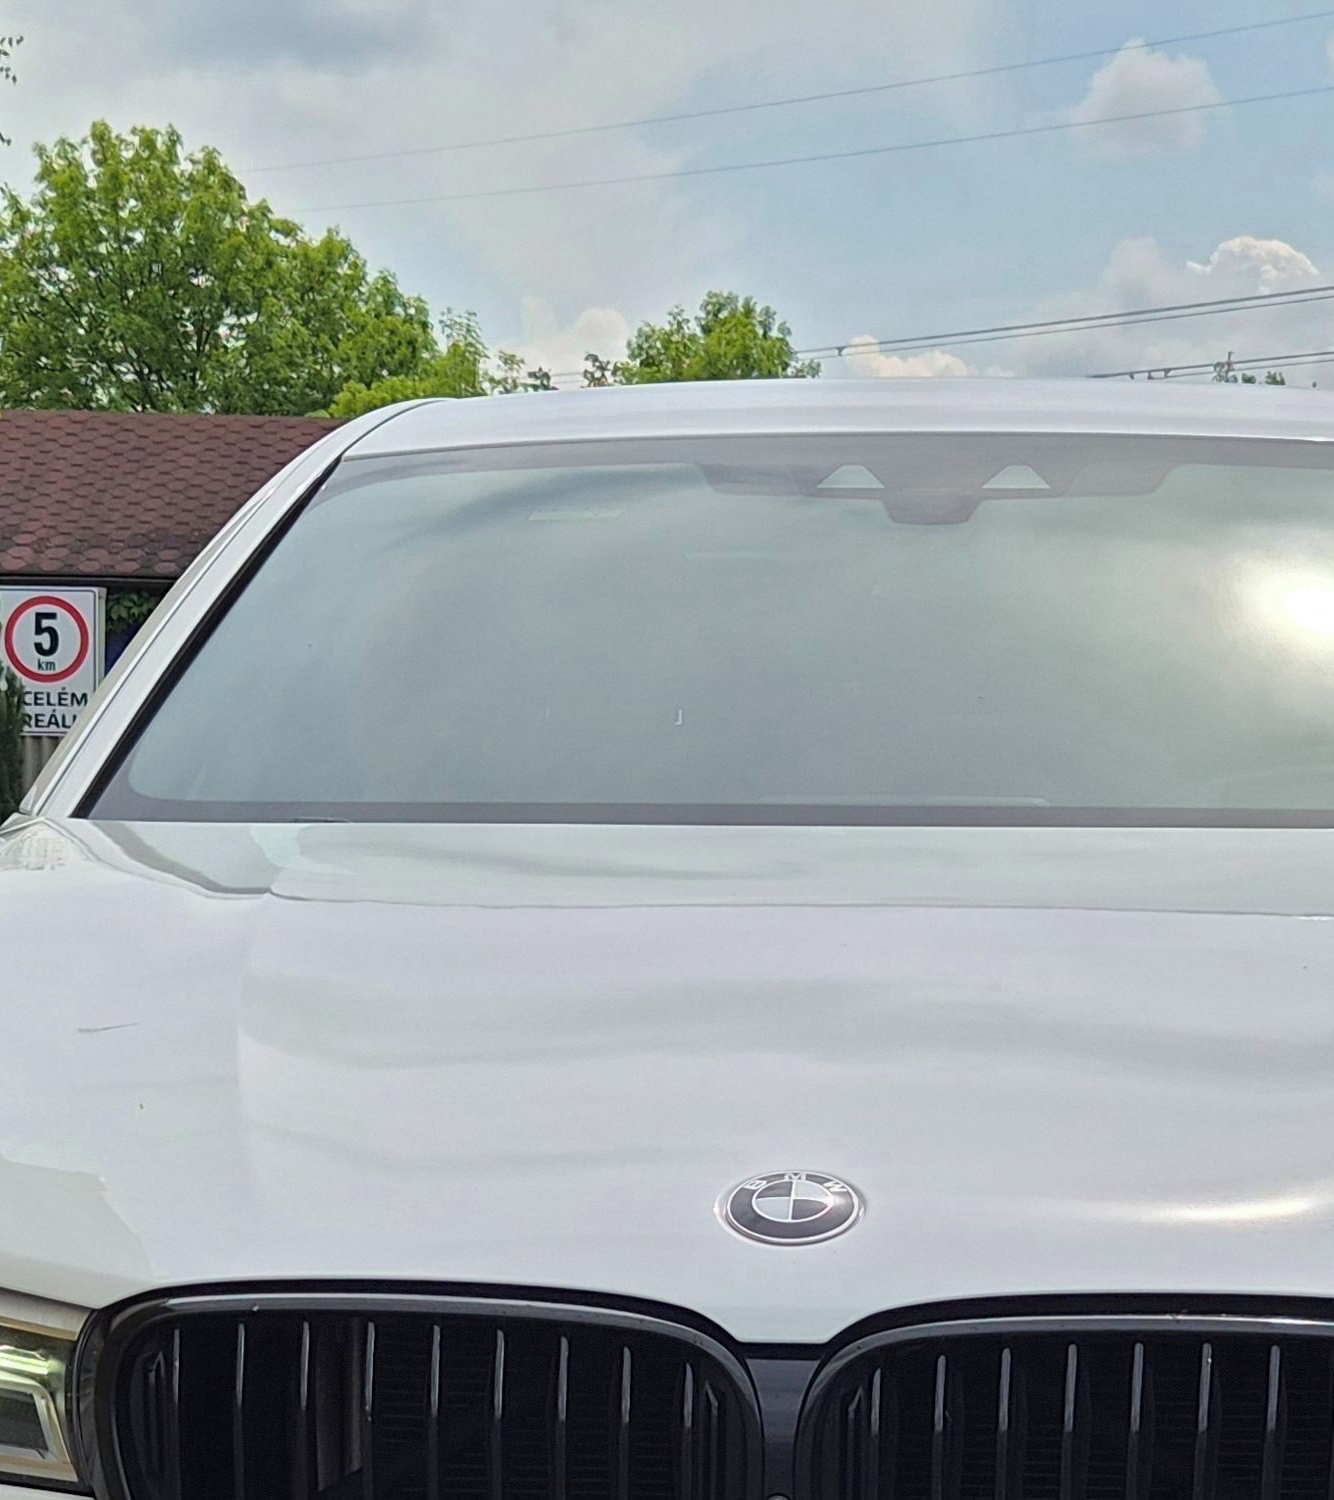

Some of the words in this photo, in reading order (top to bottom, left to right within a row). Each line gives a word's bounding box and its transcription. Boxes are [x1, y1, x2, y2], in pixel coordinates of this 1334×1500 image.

[33, 612, 59, 657] 5
[37, 658, 56, 671] km
[23, 686, 88, 707] CELÉM
[21, 708, 77, 729] REÁL
[742, 1173, 848, 1192] BMW
